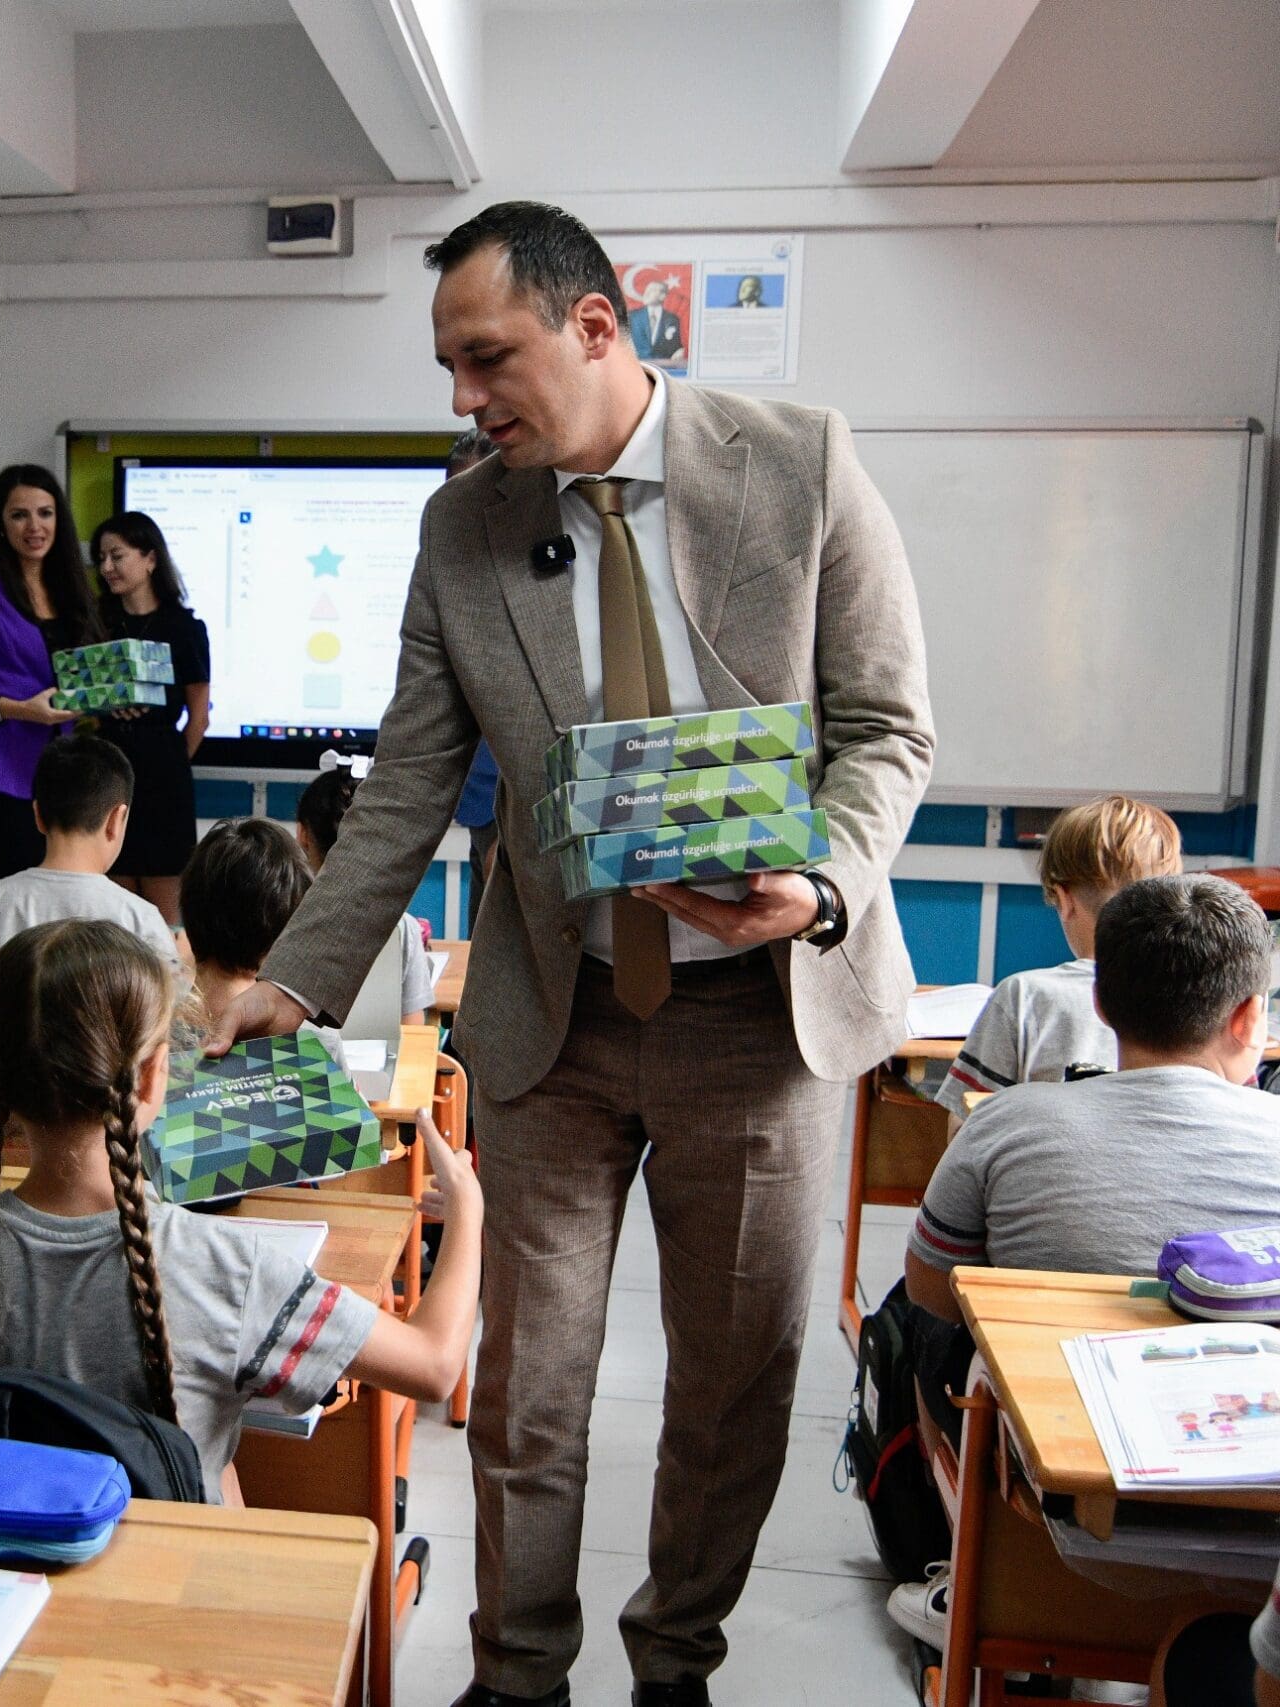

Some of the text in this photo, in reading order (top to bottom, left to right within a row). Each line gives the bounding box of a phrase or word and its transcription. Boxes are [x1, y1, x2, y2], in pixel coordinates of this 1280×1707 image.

[626, 726, 773, 751] Okumak özgürlüğe uçmaktır!
[615, 792, 660, 806] Okumak
[662, 788, 710, 803] özgürlüğe
[635, 834, 785, 861] Okumak özgürlüğe uçmaktır!
[275, 1073, 301, 1083] EGE
[206, 1091, 267, 1111] EGEV
